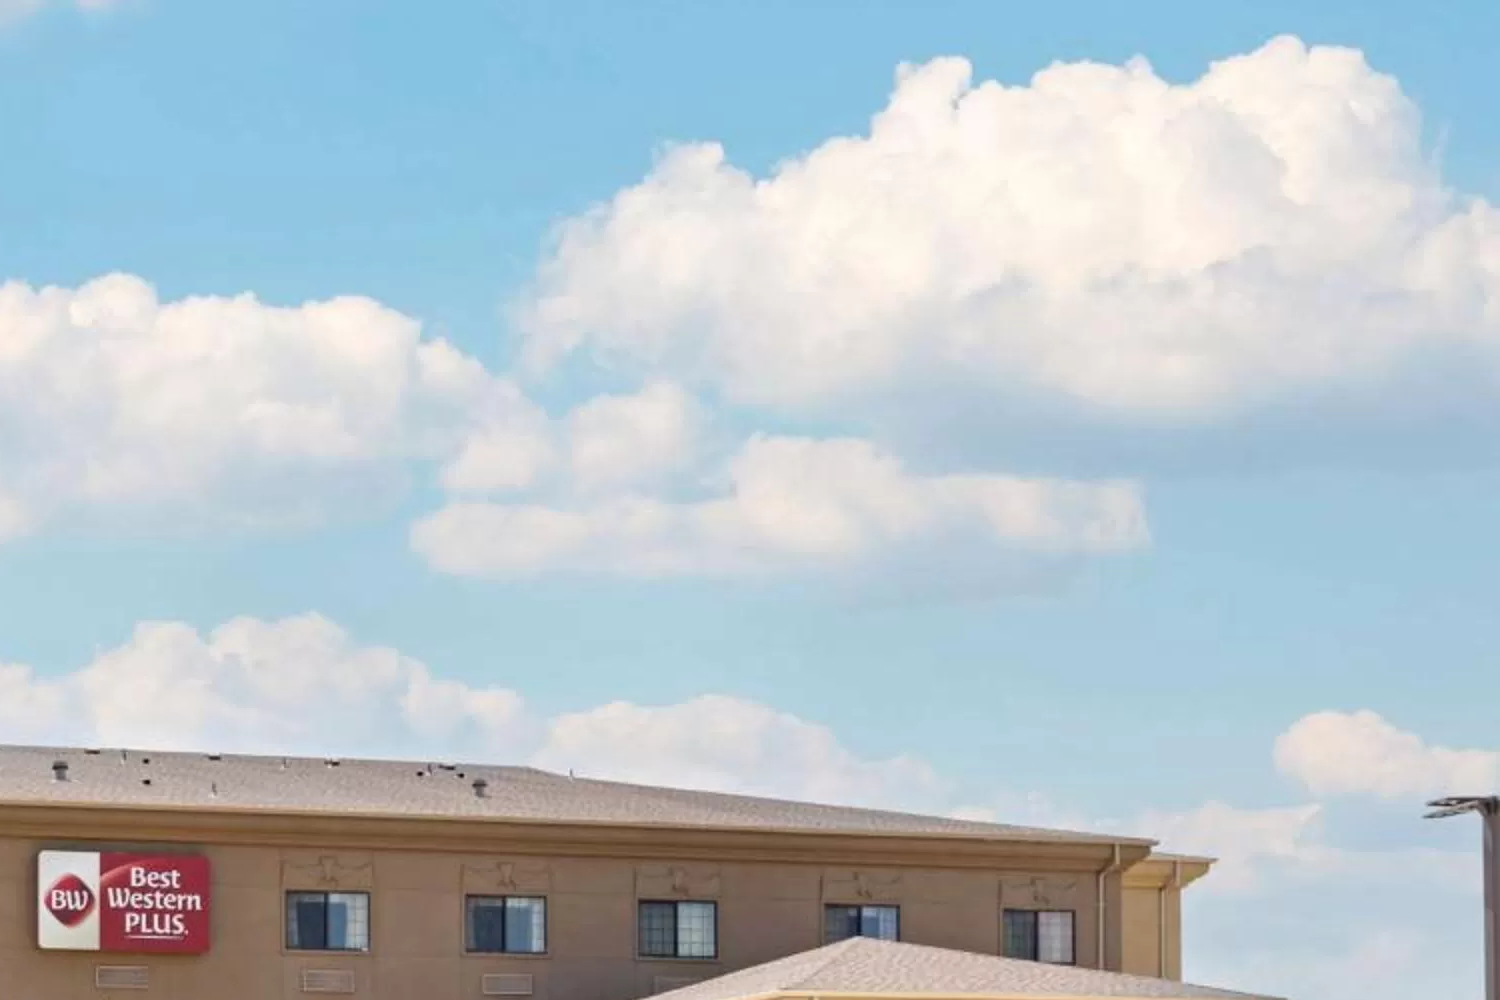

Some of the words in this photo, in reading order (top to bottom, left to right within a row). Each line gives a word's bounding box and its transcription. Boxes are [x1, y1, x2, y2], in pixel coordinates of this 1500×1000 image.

[130, 867, 181, 888] Best
[51, 889, 88, 910] BW
[107, 888, 202, 910] Western
[124, 913, 185, 934] PLUS
